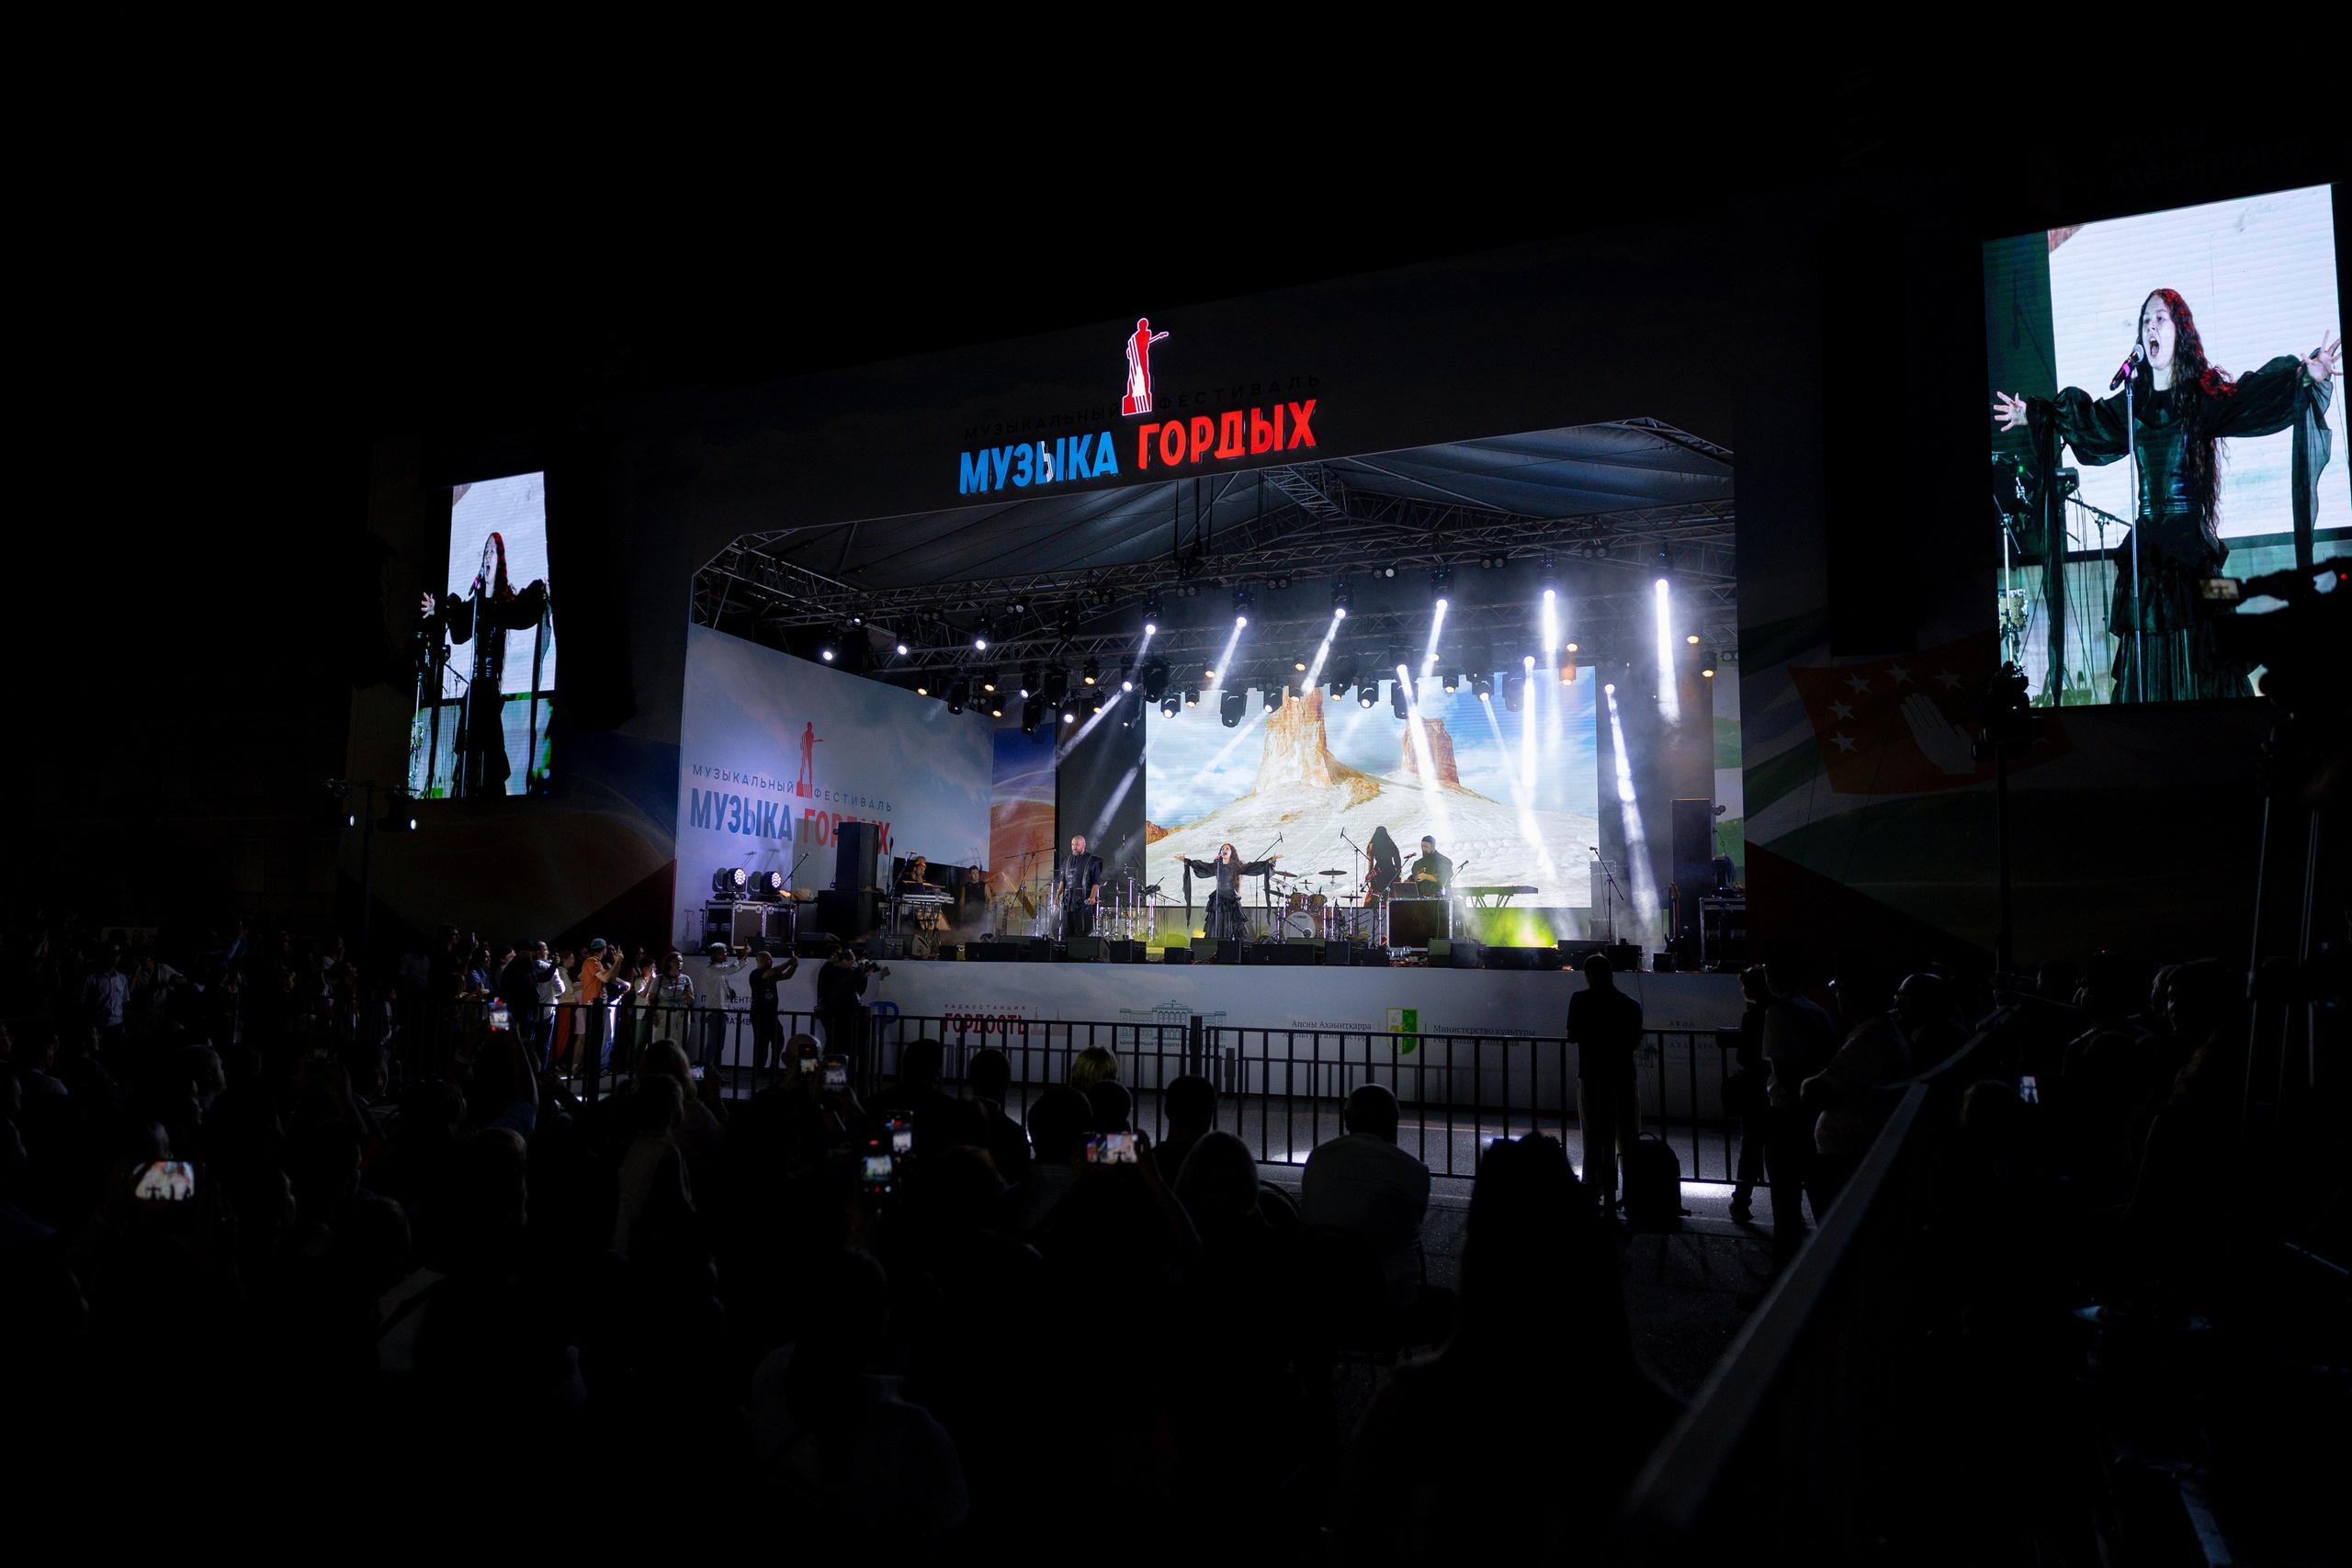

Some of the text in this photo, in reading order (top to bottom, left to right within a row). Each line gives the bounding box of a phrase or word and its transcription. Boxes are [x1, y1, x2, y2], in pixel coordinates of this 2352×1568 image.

[964, 374, 1320, 439] МУЗЫКАЛЬНЫЙ ФЕСТИВАЛЬ
[958, 398, 1317, 495] МУЗЫКА ГОРДЫХ
[693, 763, 892, 812] МУЗЫКАЛЬНЫЙ ФЕСТИВАЛЬ
[690, 787, 890, 855] МУЗЫКА ГОРХ
[944, 1012, 1025, 1035] ГОРДОСТЬ
[1433, 1024, 1536, 1036] Министерство культуры
